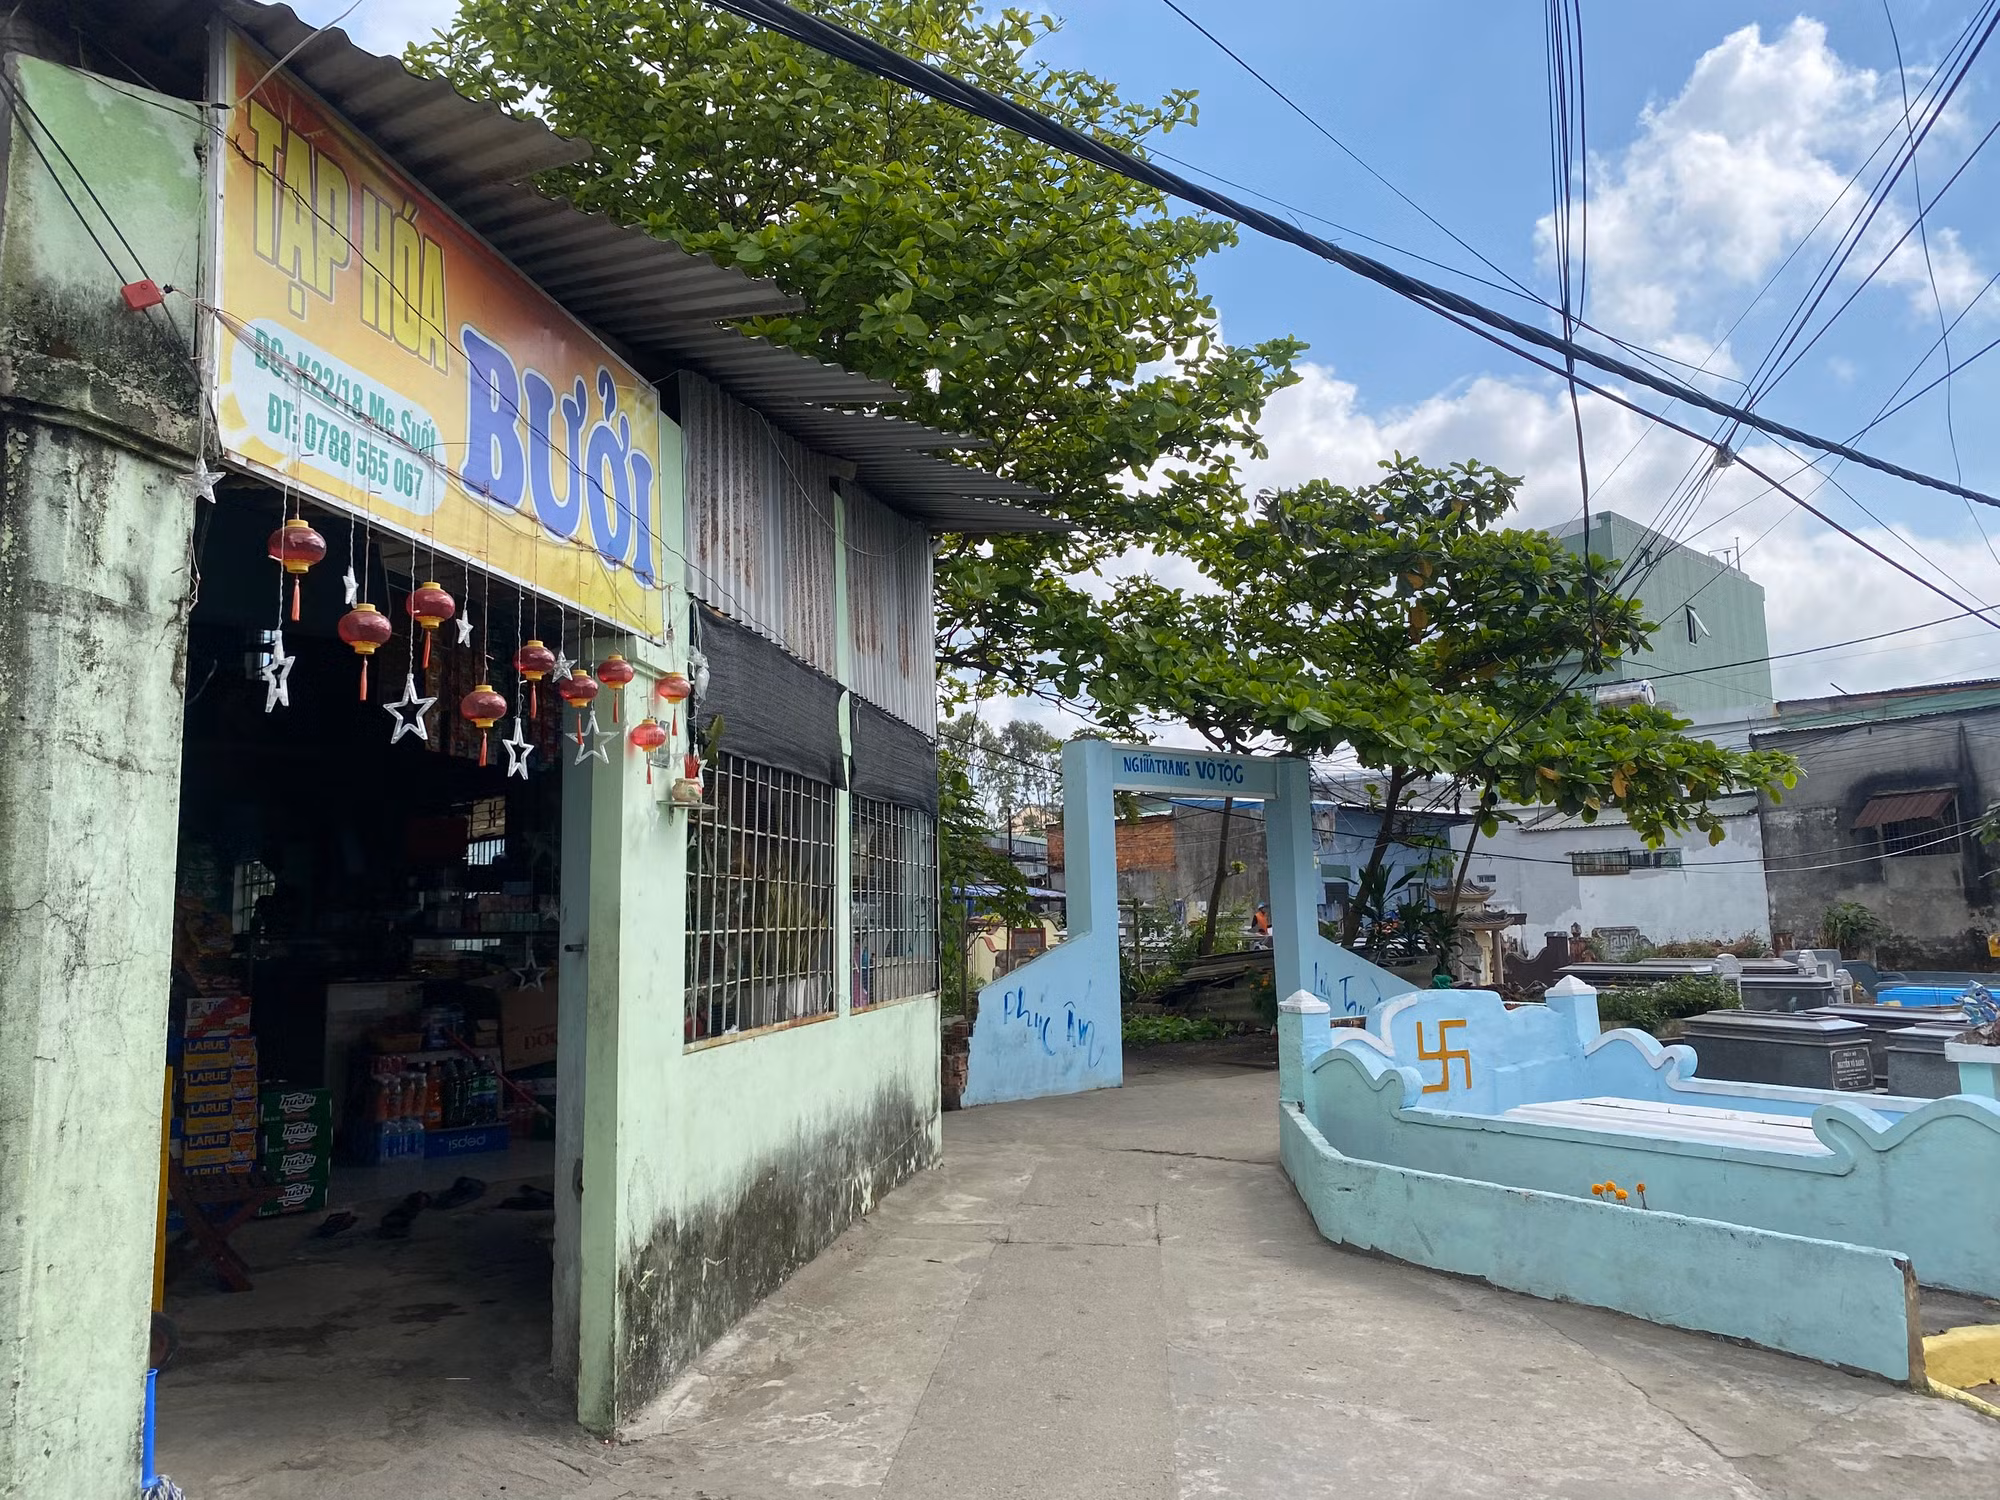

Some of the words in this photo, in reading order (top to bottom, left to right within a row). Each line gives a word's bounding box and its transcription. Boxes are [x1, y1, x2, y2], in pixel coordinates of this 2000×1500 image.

[247, 97, 351, 321] TẠP
[360, 182, 449, 376] HÓA
[297, 351, 364, 420] K22/18
[400, 409, 436, 456] Suốt
[267, 392, 298, 443] ĐT:
[304, 412, 352, 468] 0788
[356, 437, 389, 486] 555
[393, 457, 424, 501] 067
[460, 323, 656, 591] BƯỞI
[1195, 757, 1216, 780] VÕ
[188, 1039, 227, 1051] LARUE
[189, 1069, 228, 1083] LARUE
[190, 1101, 229, 1115] LARUE
[189, 1133, 227, 1147] LARUE
[448, 1133, 487, 1152] pepsi
